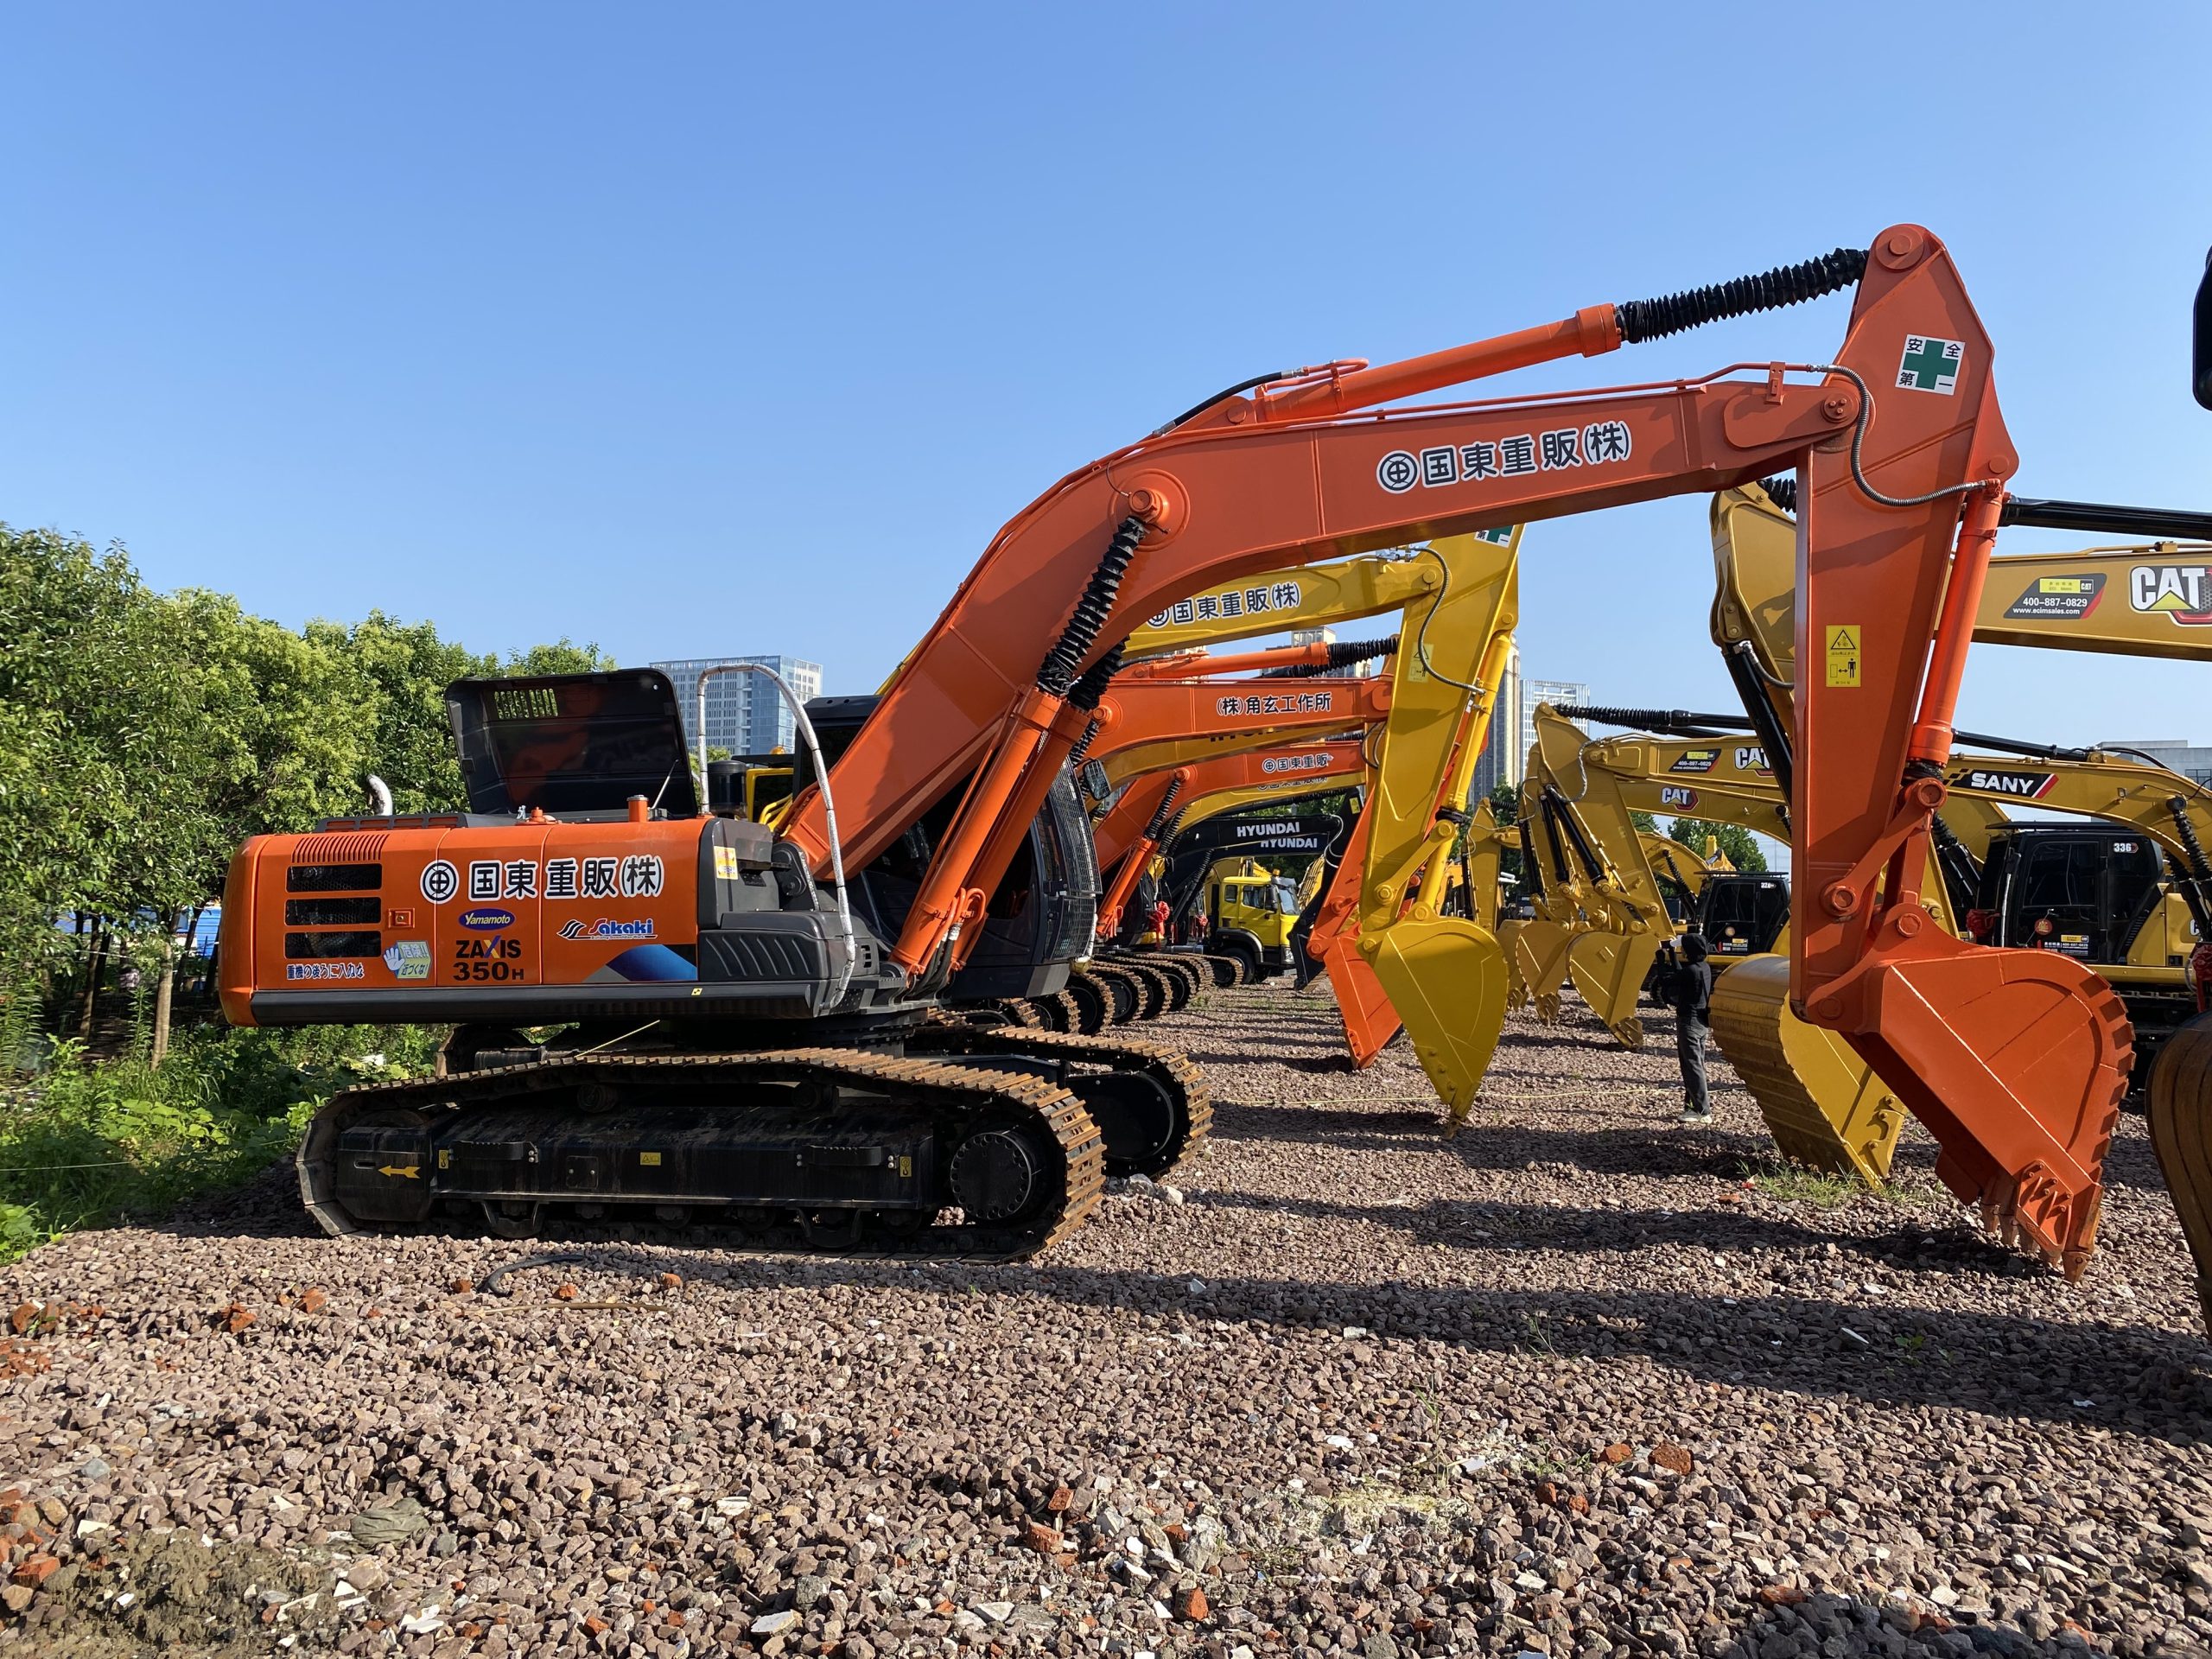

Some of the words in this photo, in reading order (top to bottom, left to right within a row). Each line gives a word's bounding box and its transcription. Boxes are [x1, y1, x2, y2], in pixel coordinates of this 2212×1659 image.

[1422, 423, 1630, 486] 国東重販(株)
[2131, 566, 2205, 610] CAT
[1173, 582, 1300, 624] 国東重販(株)
[2023, 597, 2088, 607] 400-887-0829
[1217, 692, 1332, 715] (株)角玄工作所
[1971, 772, 2034, 794] SANY
[1662, 787, 1690, 804] CAT
[1236, 822, 1300, 836] HYUNDAI
[2113, 842, 2132, 853] 336
[471, 856, 662, 898] 国東重販(株)
[465, 912, 511, 925] Yamamoto
[588, 918, 653, 934] Sakaki
[455, 935, 522, 959] ZAXIS
